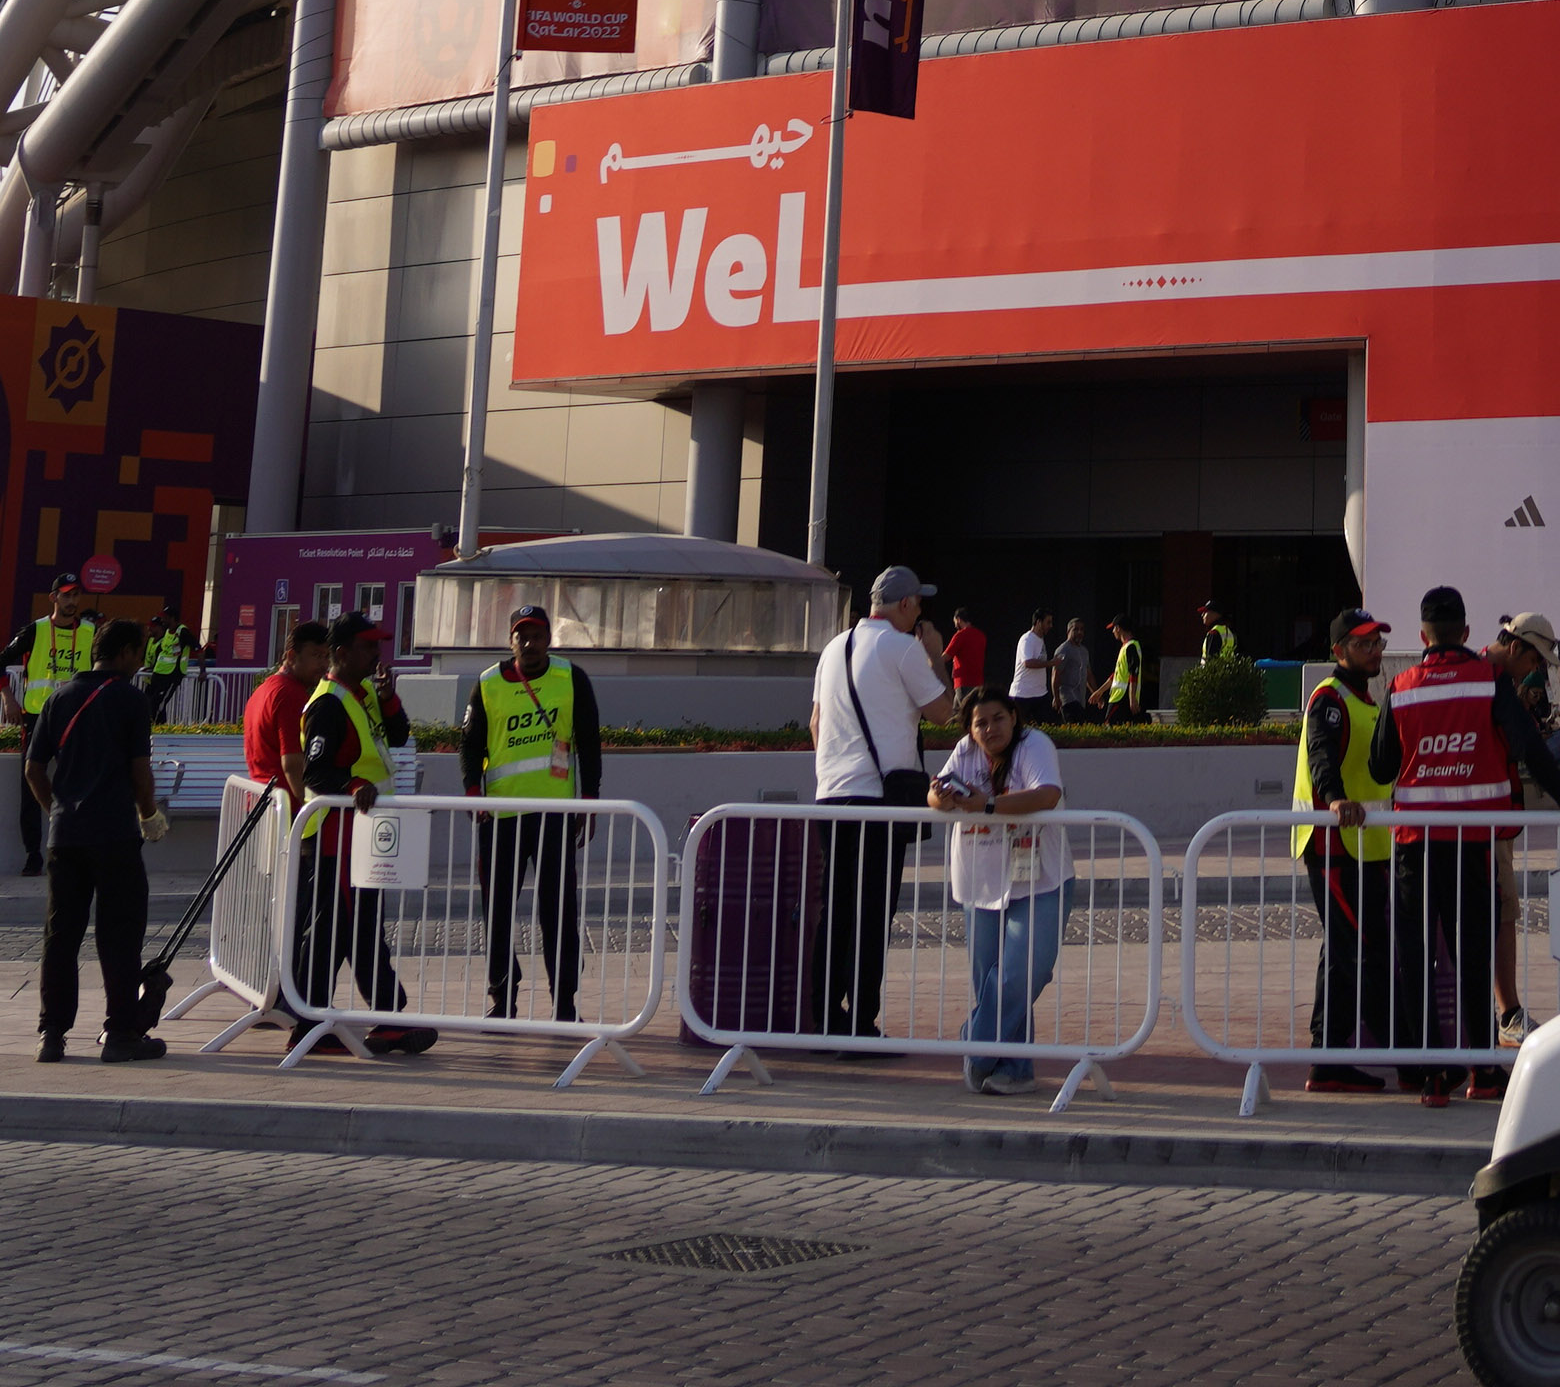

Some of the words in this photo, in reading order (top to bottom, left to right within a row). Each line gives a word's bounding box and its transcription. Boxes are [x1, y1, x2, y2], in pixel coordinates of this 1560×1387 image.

[553, 12, 601, 24] WORLD
[603, 13, 628, 25] CUP
[527, 22, 620, 39] Qatar2022
[299, 548, 316, 558] Ticket
[316, 548, 347, 558] Resolution
[348, 547, 364, 558] Point
[507, 707, 558, 732] 0371
[1418, 731, 1477, 756] 0022
[1416, 761, 1474, 779] Security
